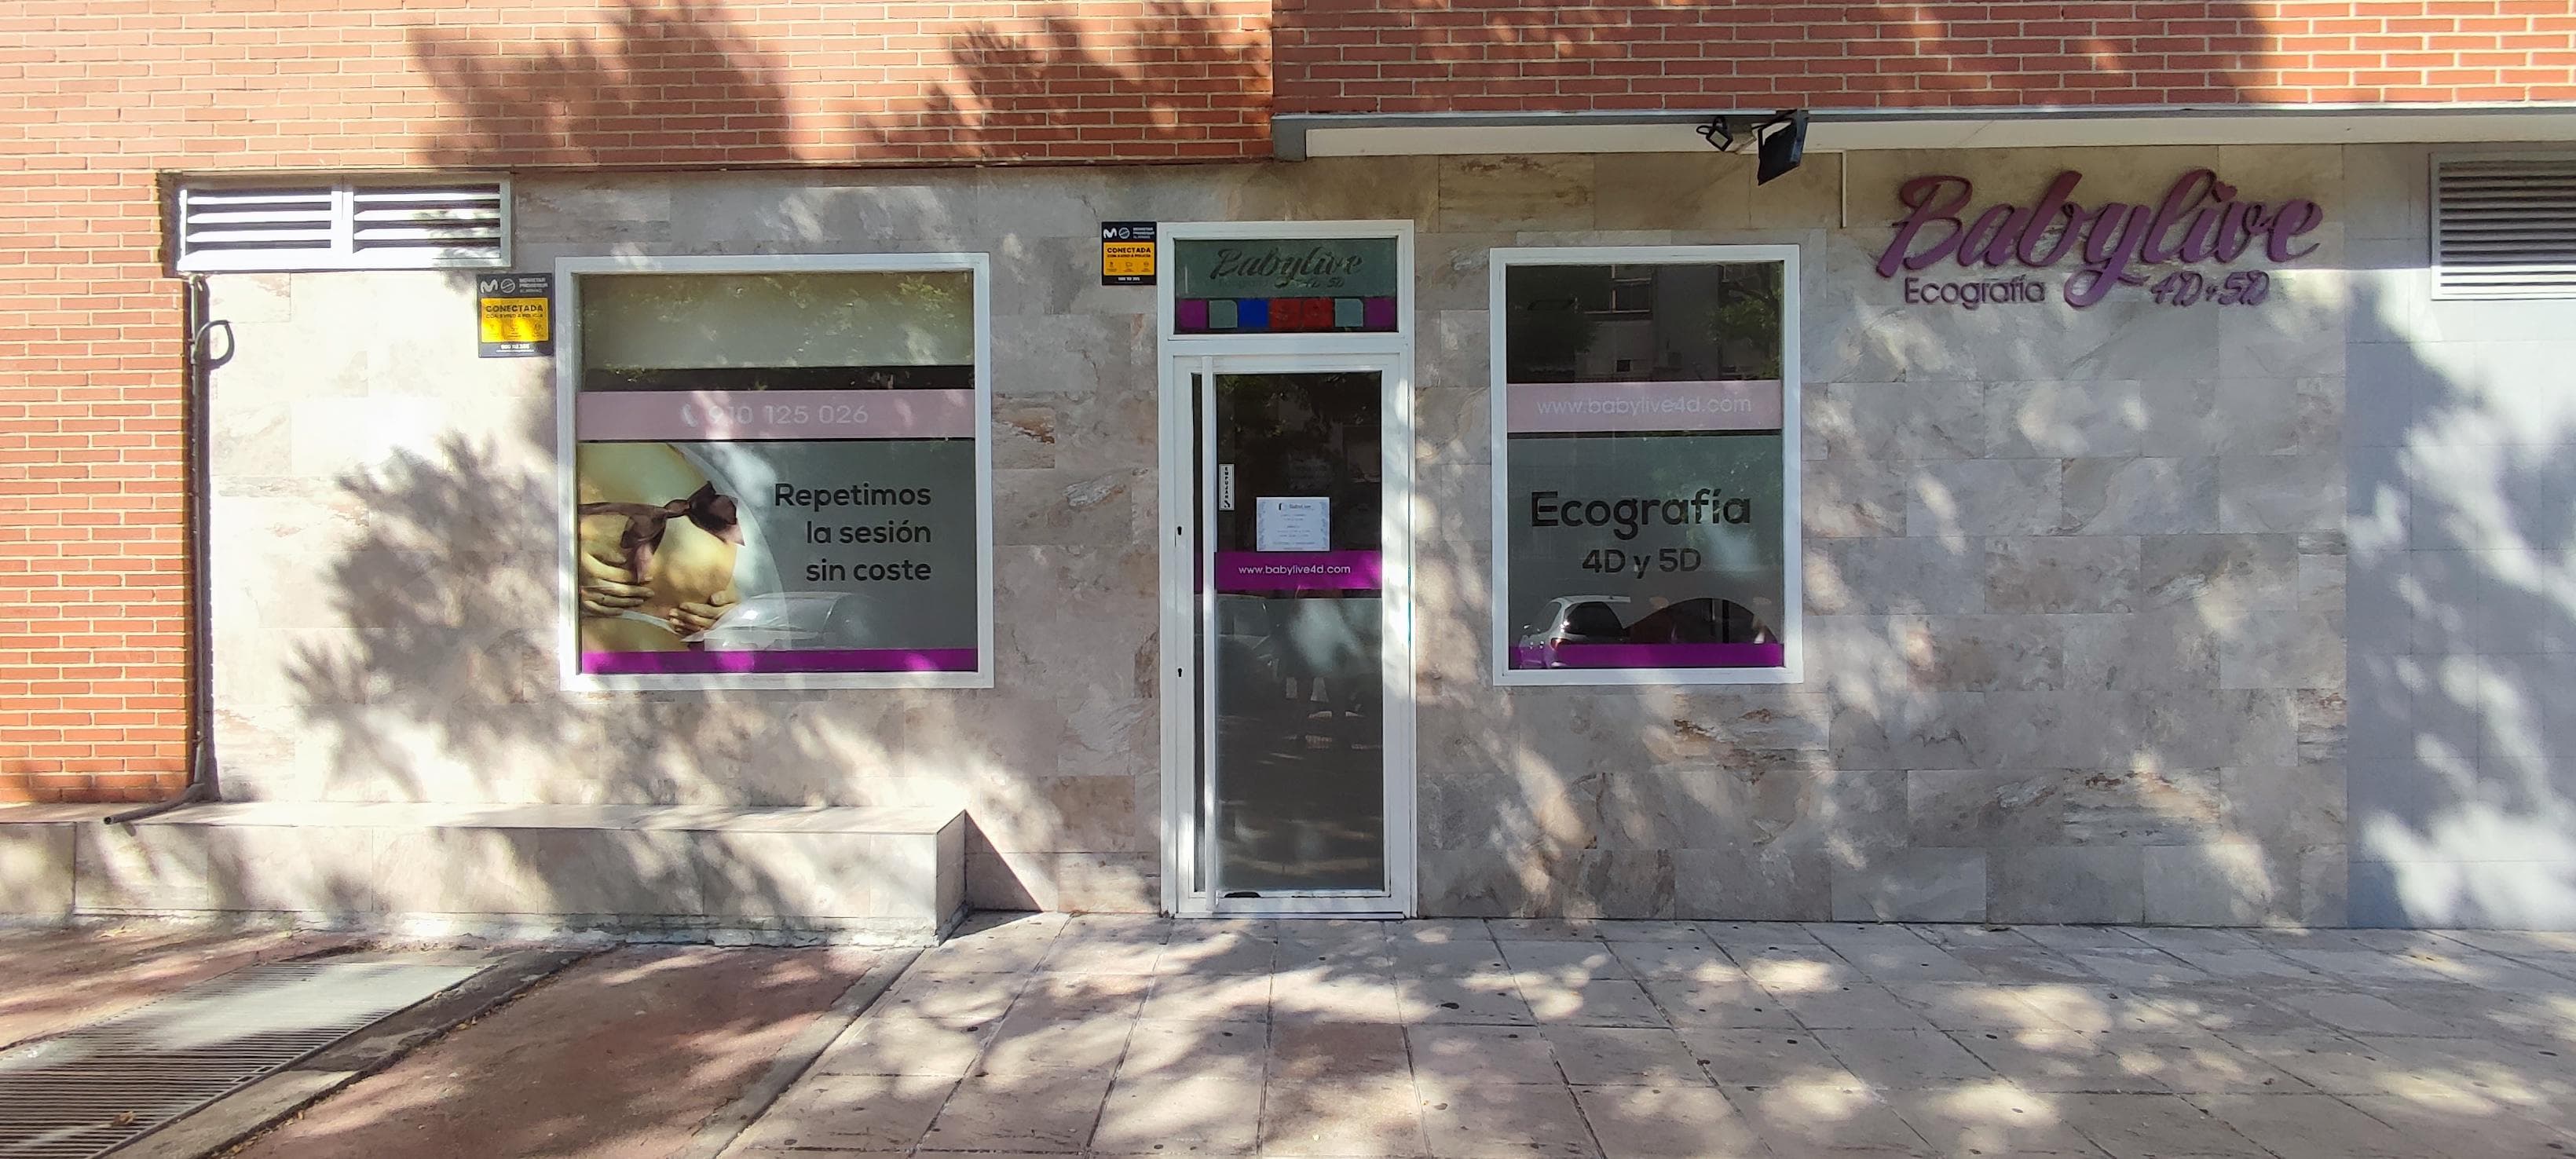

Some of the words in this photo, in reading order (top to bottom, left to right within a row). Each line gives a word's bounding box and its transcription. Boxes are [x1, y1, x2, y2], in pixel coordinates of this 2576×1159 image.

[1875, 168, 2323, 309] Babylive
[708, 404, 754, 425] 910
[765, 404, 809, 425] 125
[818, 403, 869, 424] 026
[1536, 394, 1753, 417] www.babylive4d.com
[774, 483, 931, 513] Repetimos
[1530, 487, 1751, 540] Ecografía
[807, 521, 831, 543] la
[840, 520, 931, 543] sesión
[807, 558, 845, 582] sin
[853, 561, 932, 582] coste
[1239, 565, 1351, 576] www.babylive4d.com
[1582, 548, 1626, 573] 4D
[1633, 554, 1650, 580] y
[1659, 548, 1702, 572] 5D
